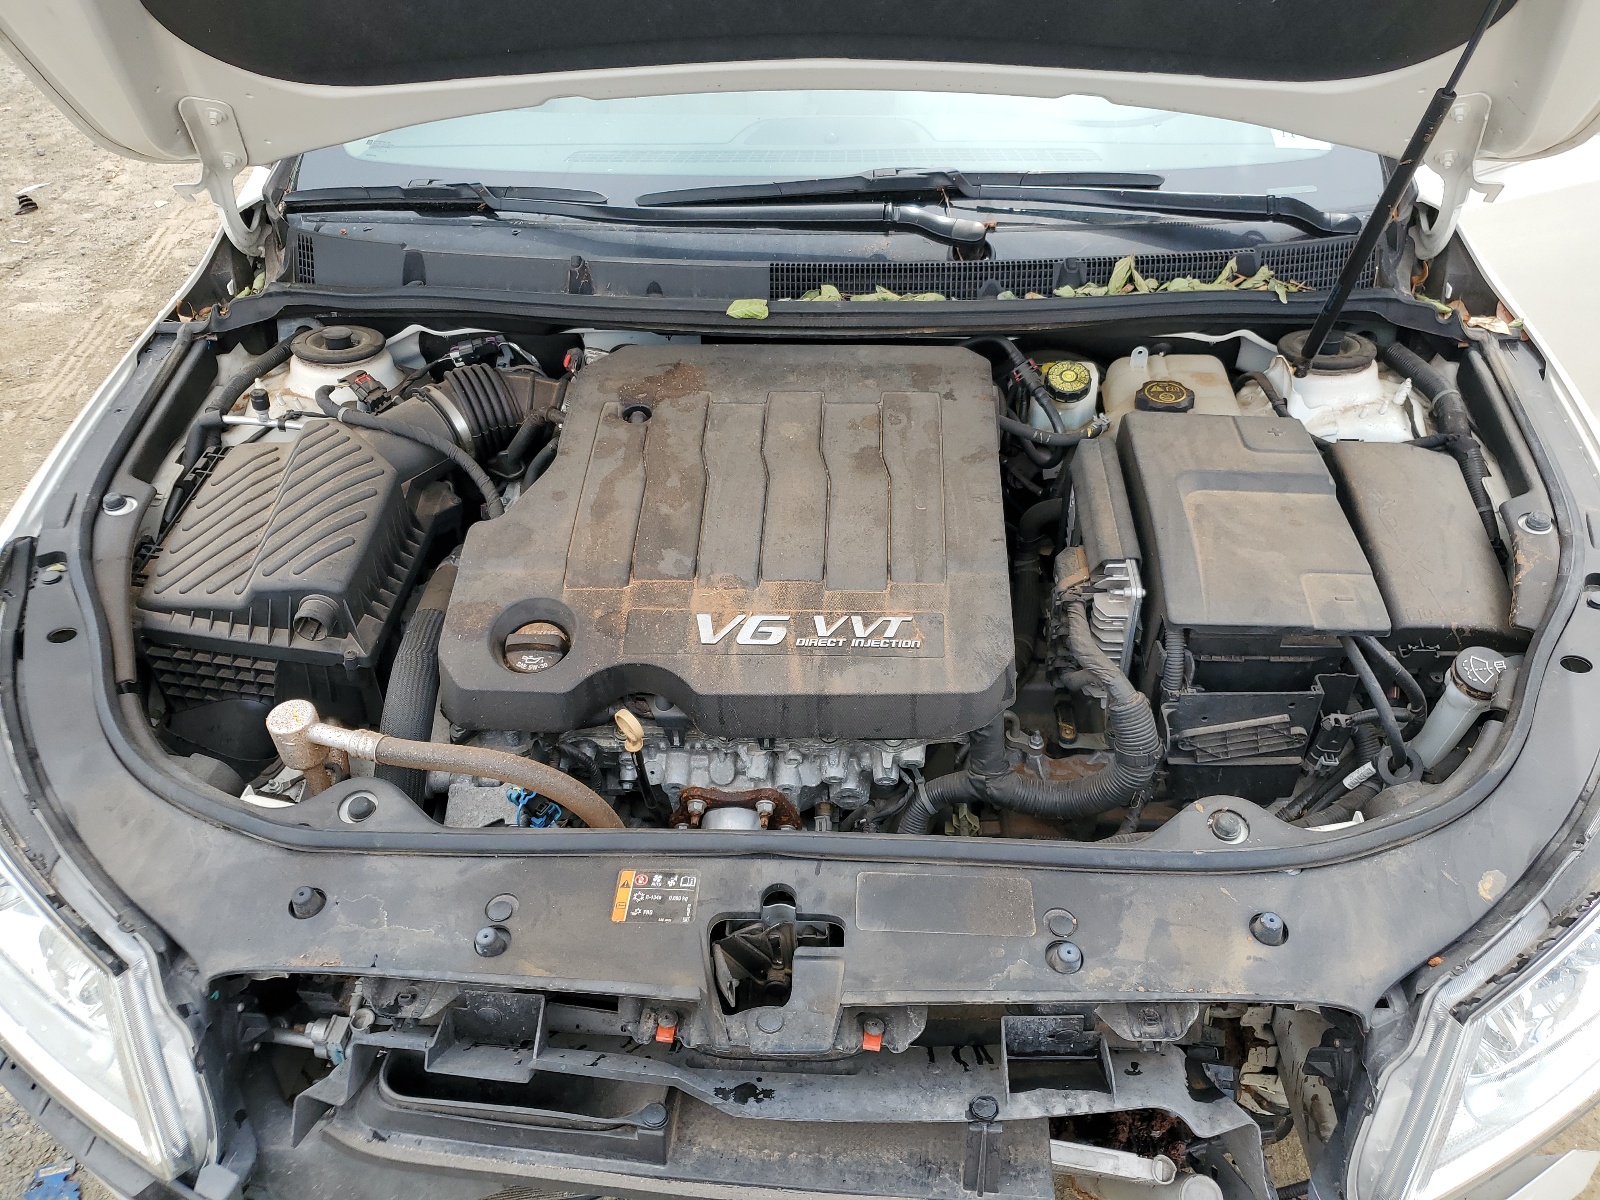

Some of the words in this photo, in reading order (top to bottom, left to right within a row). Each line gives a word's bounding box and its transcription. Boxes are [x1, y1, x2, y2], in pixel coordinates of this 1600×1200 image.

[696, 613, 791, 645] V6
[813, 615, 913, 639] VVT
[795, 638, 847, 648] DIRECT
[850, 638, 921, 649] INJECTION
